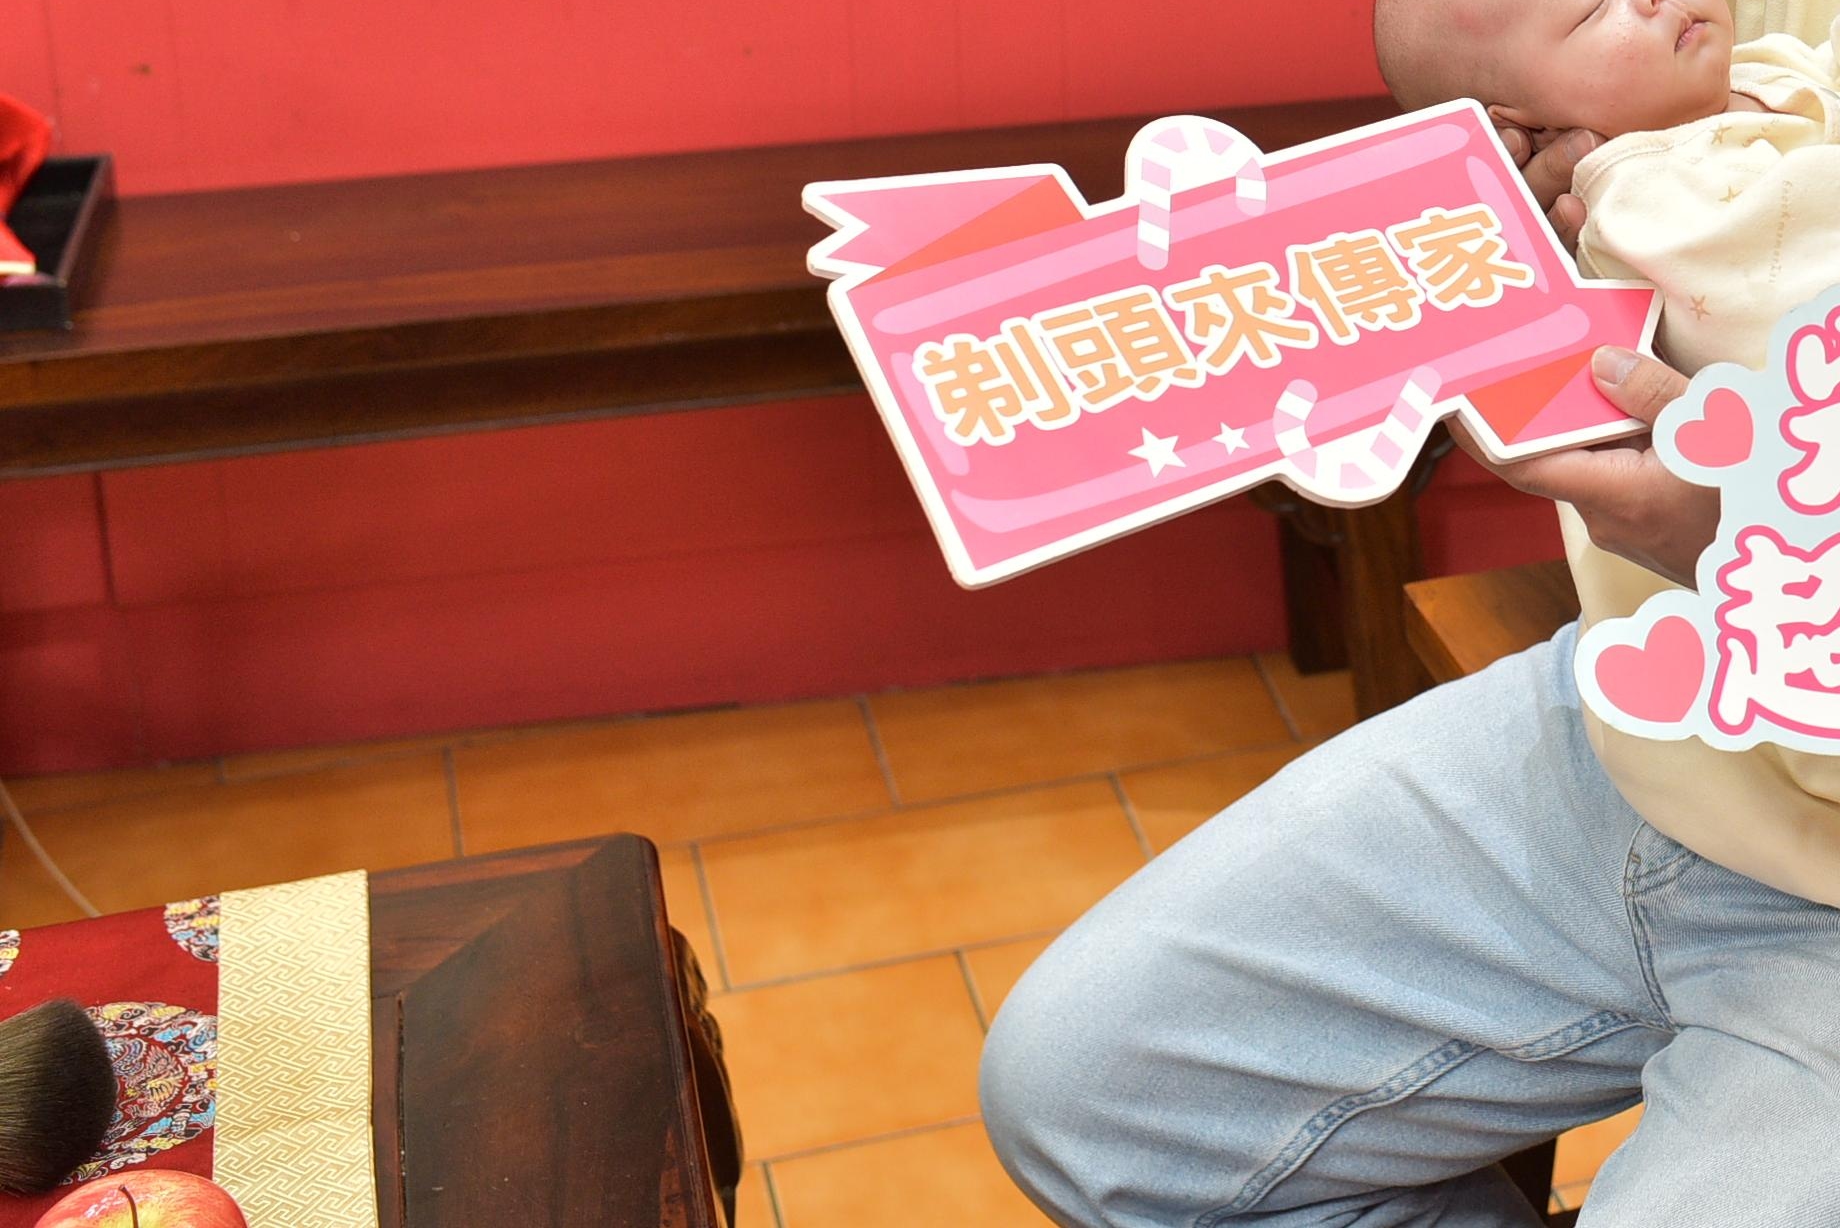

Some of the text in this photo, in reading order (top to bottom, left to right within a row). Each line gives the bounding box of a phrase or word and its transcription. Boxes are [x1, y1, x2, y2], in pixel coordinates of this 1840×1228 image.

[916, 204, 1533, 442] 剃頭來傳家
